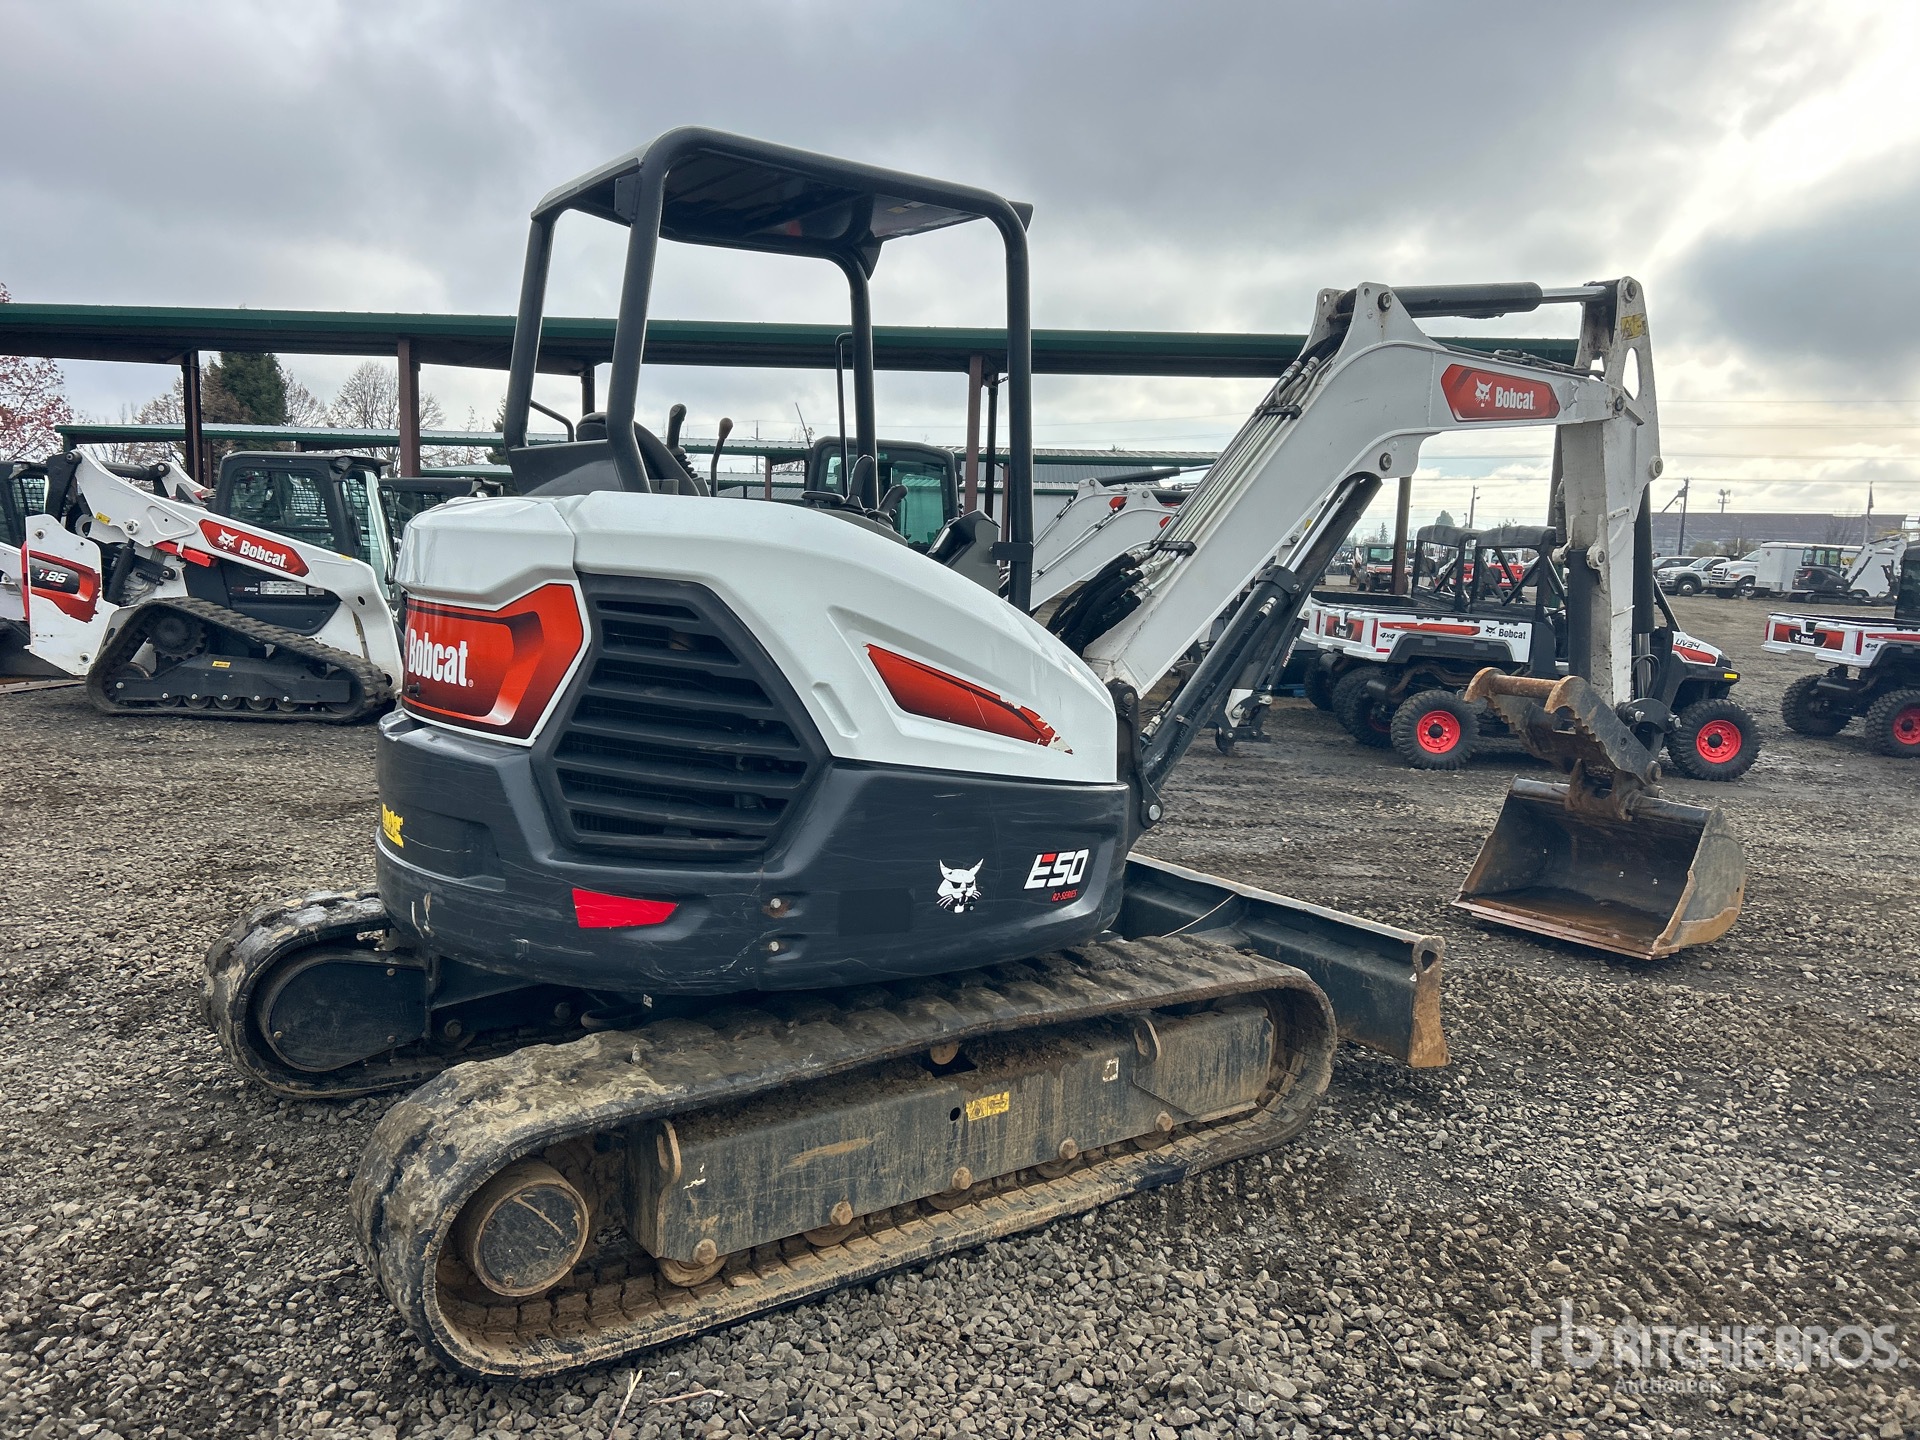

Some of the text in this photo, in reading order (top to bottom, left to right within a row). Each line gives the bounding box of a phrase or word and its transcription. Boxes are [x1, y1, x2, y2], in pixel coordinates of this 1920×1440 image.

[1495, 386, 1534, 410] Bobcat
[240, 540, 286, 568] Bobcat
[39, 569, 68, 583] T86
[1380, 632, 1396, 640] 4x4
[1498, 628, 1526, 639] Bobcat
[1675, 638, 1700, 650] UV34
[408, 628, 468, 687] Bobcat
[1024, 849, 1089, 889] E50
